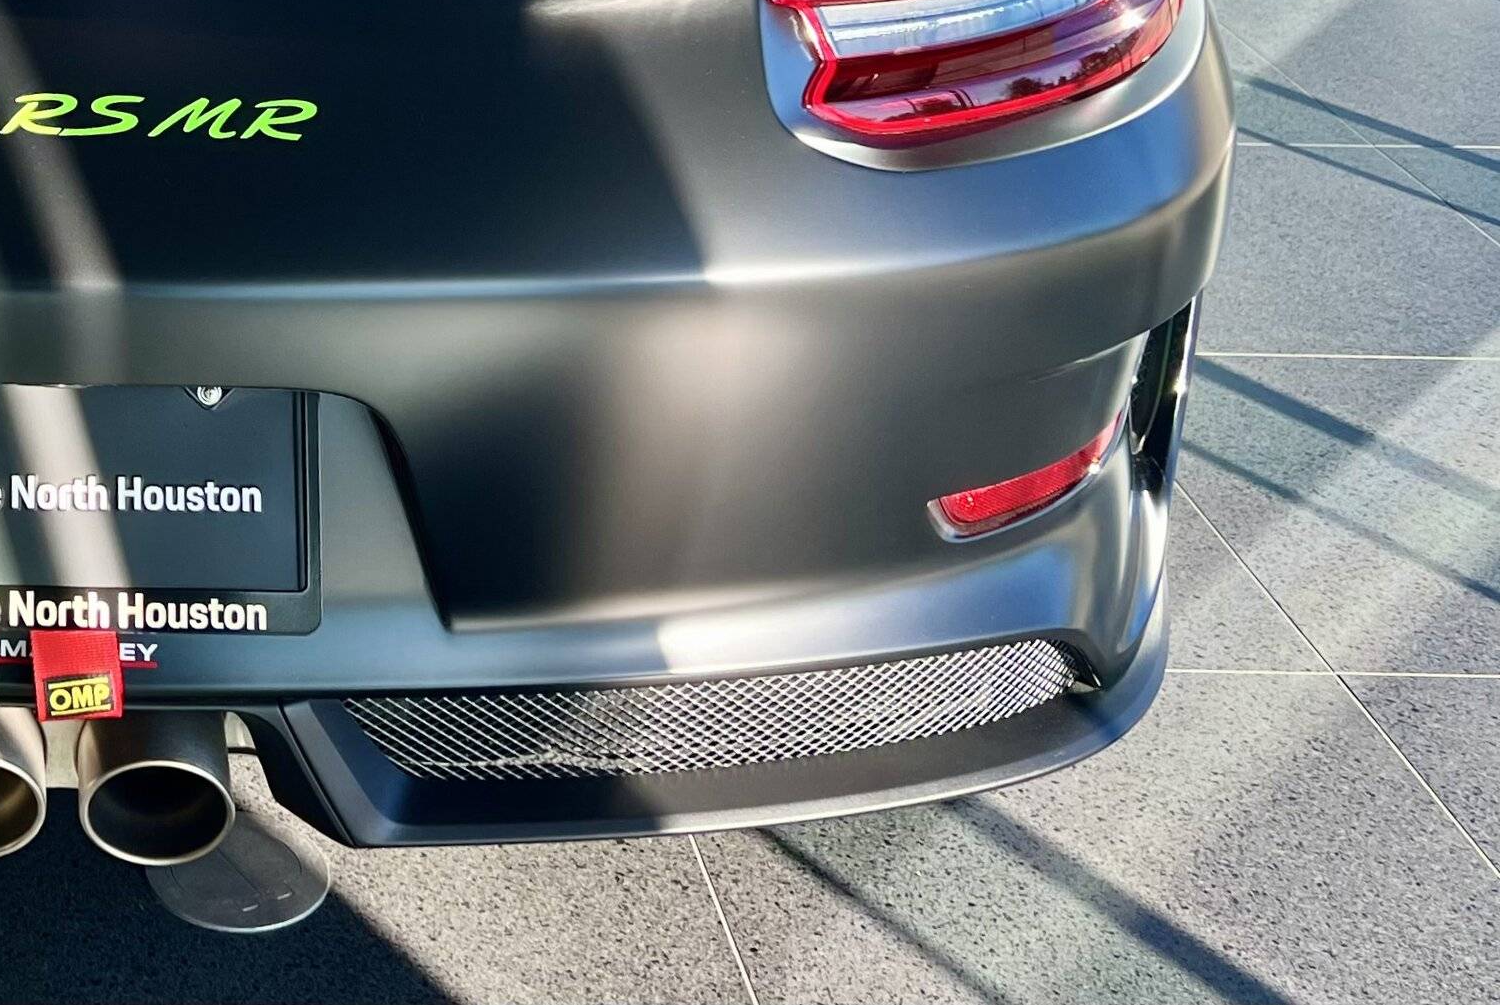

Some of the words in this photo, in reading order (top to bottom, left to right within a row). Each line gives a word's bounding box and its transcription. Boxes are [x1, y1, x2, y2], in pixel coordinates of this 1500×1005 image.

[147, 97, 319, 142] MR
[10, 475, 109, 512] North
[116, 476, 263, 513] Houston
[8, 589, 110, 629] North
[117, 592, 268, 631] Houston
[49, 683, 111, 711] OMP
